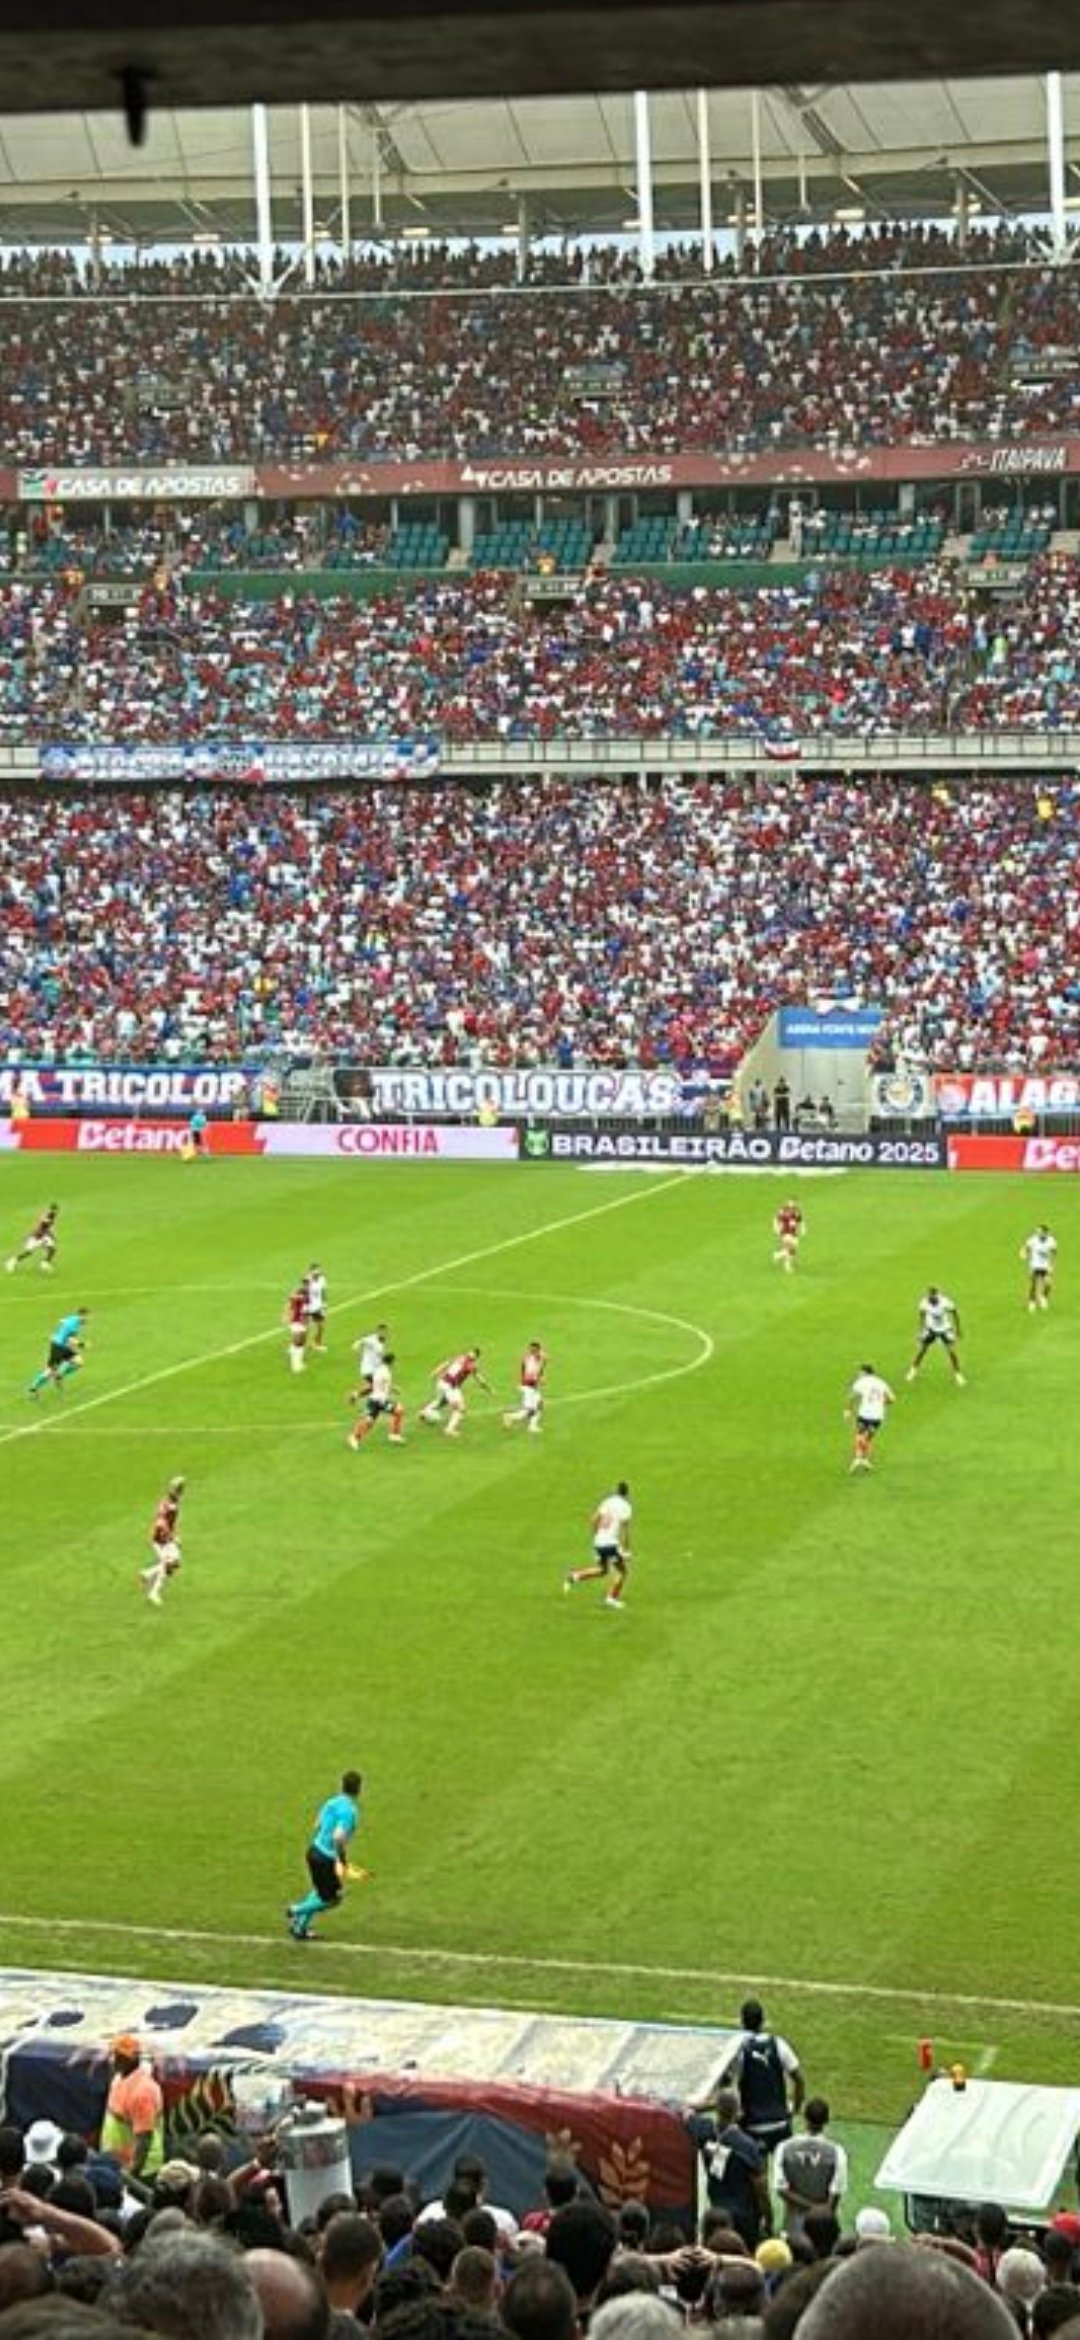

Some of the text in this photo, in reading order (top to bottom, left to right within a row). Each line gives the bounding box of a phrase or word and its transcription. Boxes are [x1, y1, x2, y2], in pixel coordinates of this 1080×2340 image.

[990, 447, 1066, 472] ITAIPAVA
[57, 475, 240, 497] CASA DE APOSTAS
[488, 465, 672, 488] CASA DE APOSTAS
[372, 1071, 679, 1115] TRICOLOUCAS
[337, 1127, 439, 1154] CONFIA
[552, 1132, 940, 1163] BRASILEIRÃO Betano 2025
[795, 2150, 821, 2168] TV
